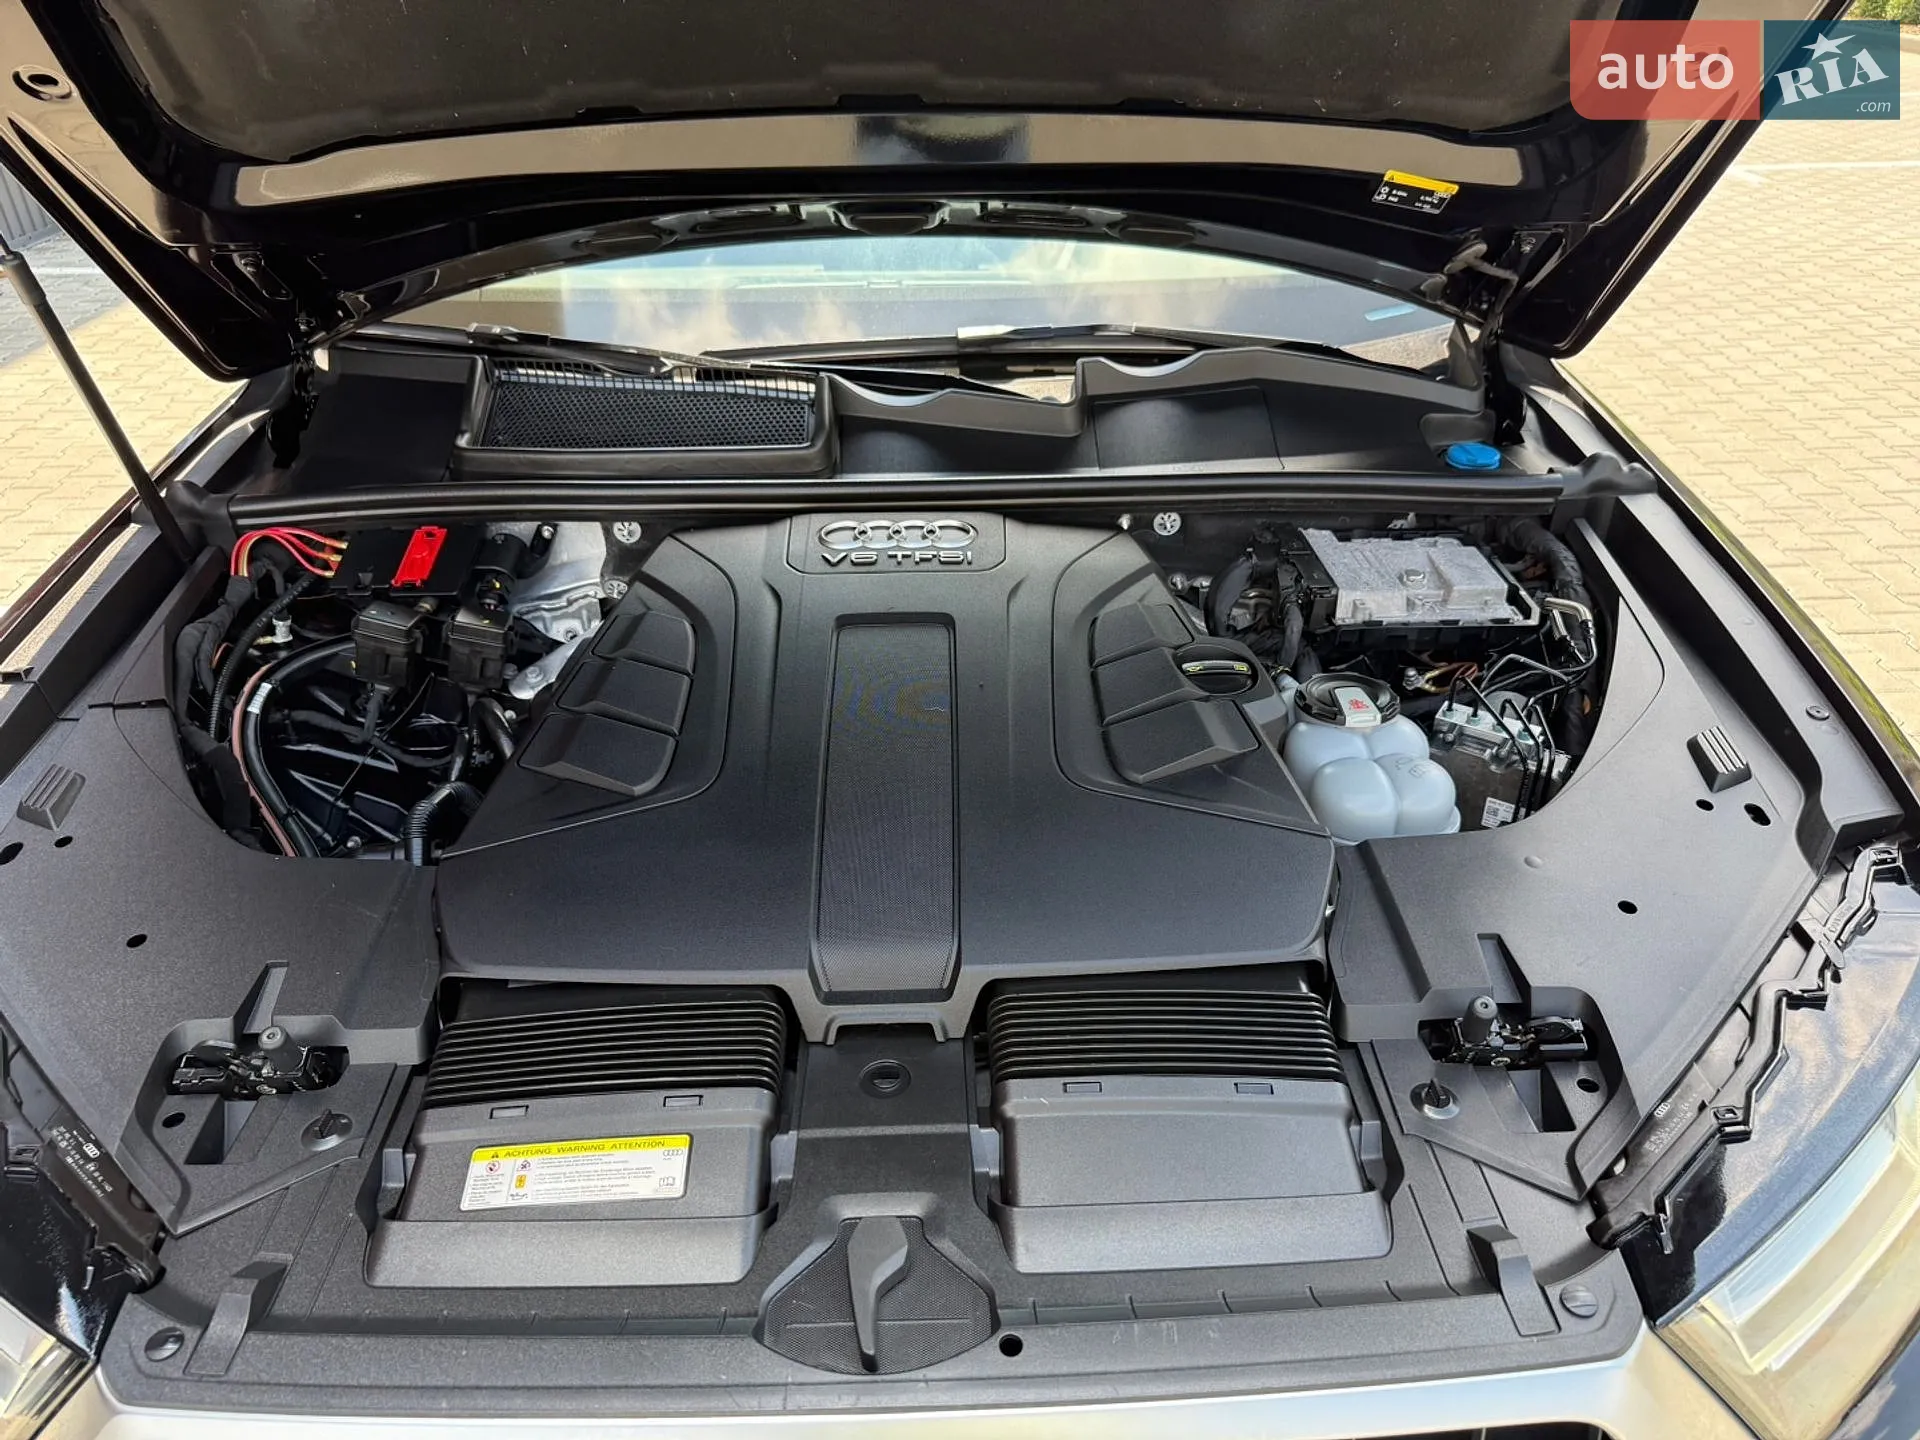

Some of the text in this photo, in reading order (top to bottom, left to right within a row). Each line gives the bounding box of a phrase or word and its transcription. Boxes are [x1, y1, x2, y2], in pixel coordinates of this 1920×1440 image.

[821, 550, 973, 567] V6 TFSI
[503, 1148, 551, 1158] ACHTUNG
[557, 1144, 605, 1154] WARNING
[610, 1140, 665, 1150] ATTENTION
